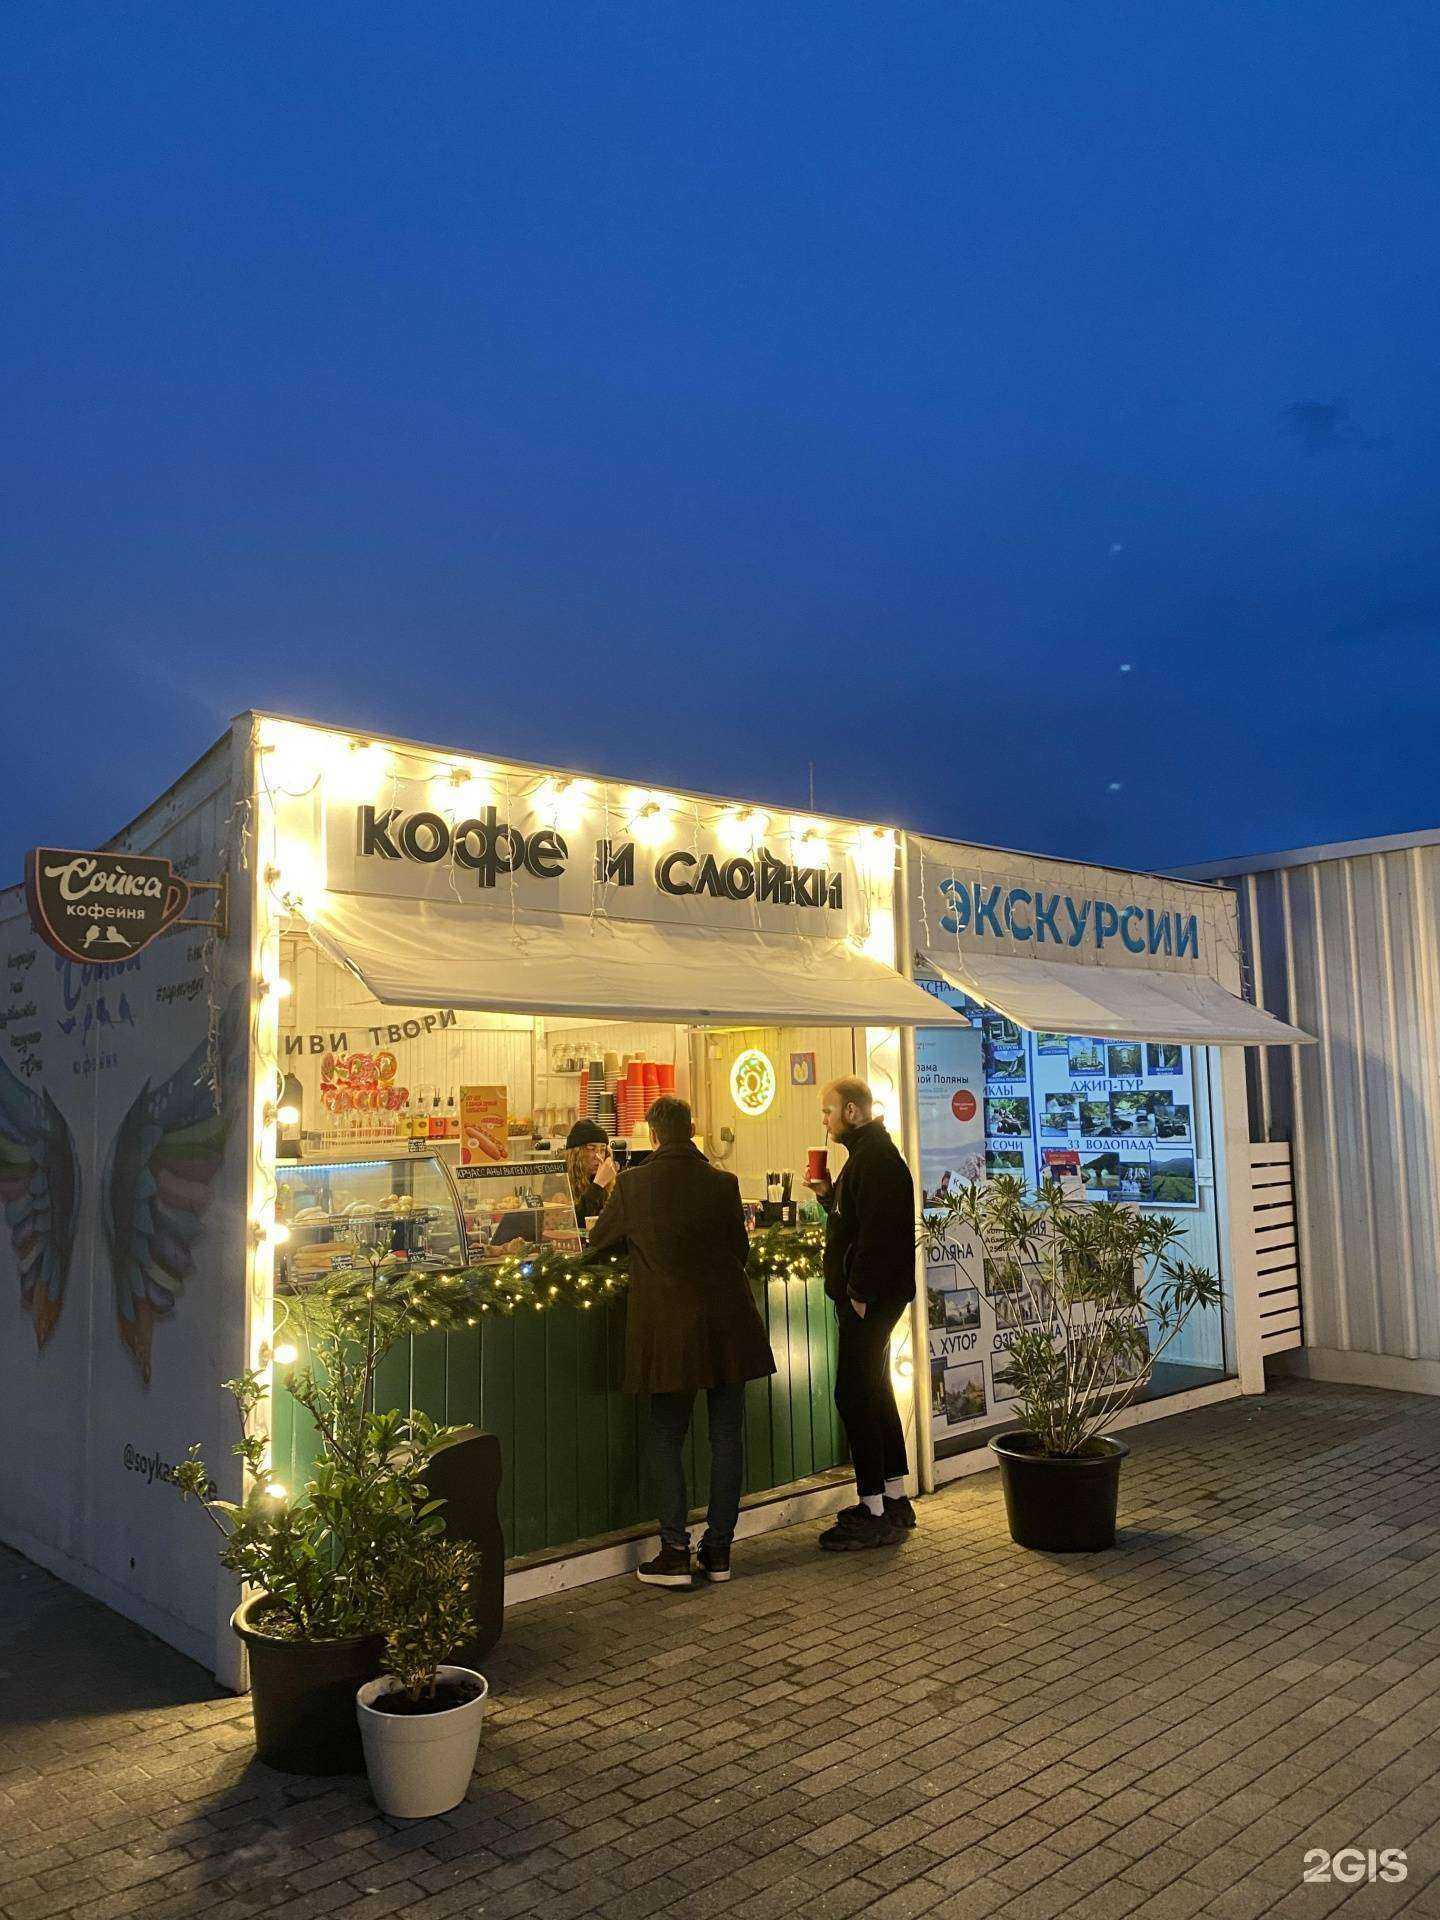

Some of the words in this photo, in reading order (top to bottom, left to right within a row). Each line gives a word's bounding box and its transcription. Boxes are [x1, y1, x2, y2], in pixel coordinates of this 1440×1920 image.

[45, 857, 163, 902] Сойка
[66, 903, 146, 920] кофейня
[938, 877, 1200, 960] ЭКСКУРСИИ
[369, 1008, 458, 1047] ТВОРИ
[933, 1074, 969, 1085] Поляны
[1070, 1079, 1144, 1092] ДЖИП-ТУР
[992, 1140, 1024, 1151] СОЧИ
[1067, 1139, 1080, 1150] 33
[1086, 1139, 1156, 1151] ВОДОПАДА
[941, 1333, 978, 1355] ХУТОР
